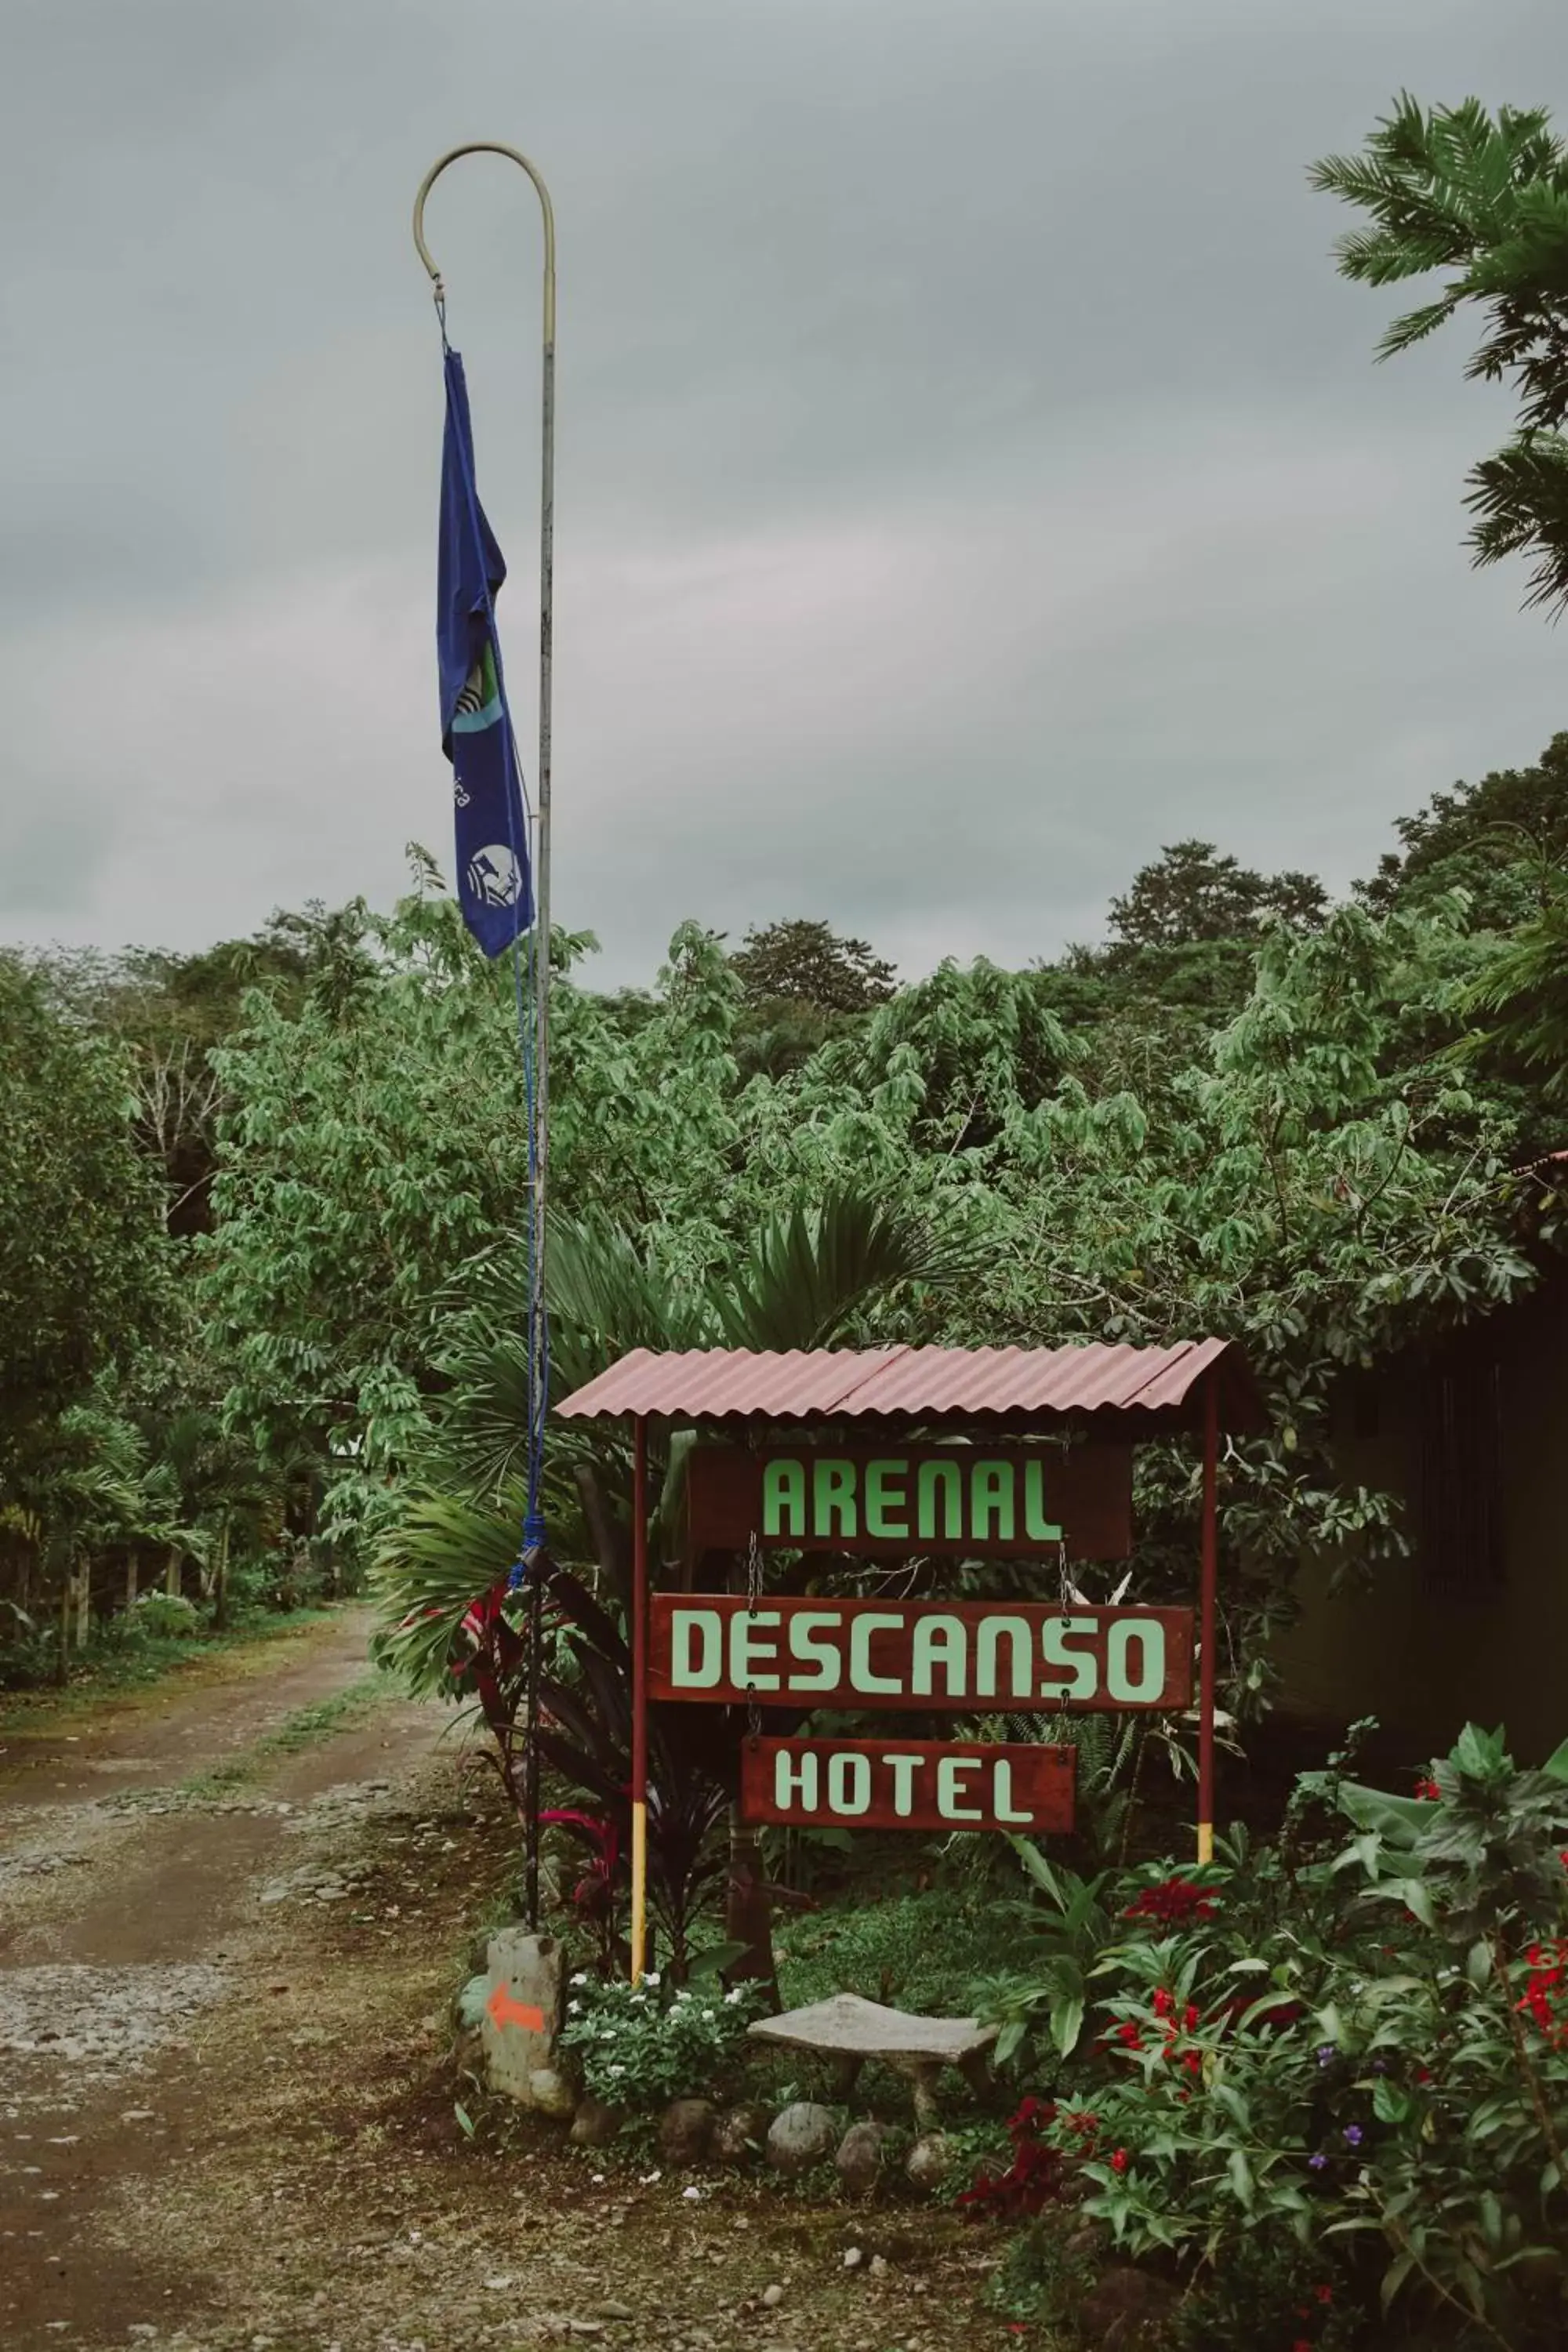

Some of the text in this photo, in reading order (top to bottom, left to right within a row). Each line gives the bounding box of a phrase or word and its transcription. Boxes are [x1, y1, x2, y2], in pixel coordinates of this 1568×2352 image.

[764, 1460, 1062, 1541] ARENAL
[673, 1610, 1164, 1703] DESCANSO
[775, 1750, 1035, 1823] HOTEL
